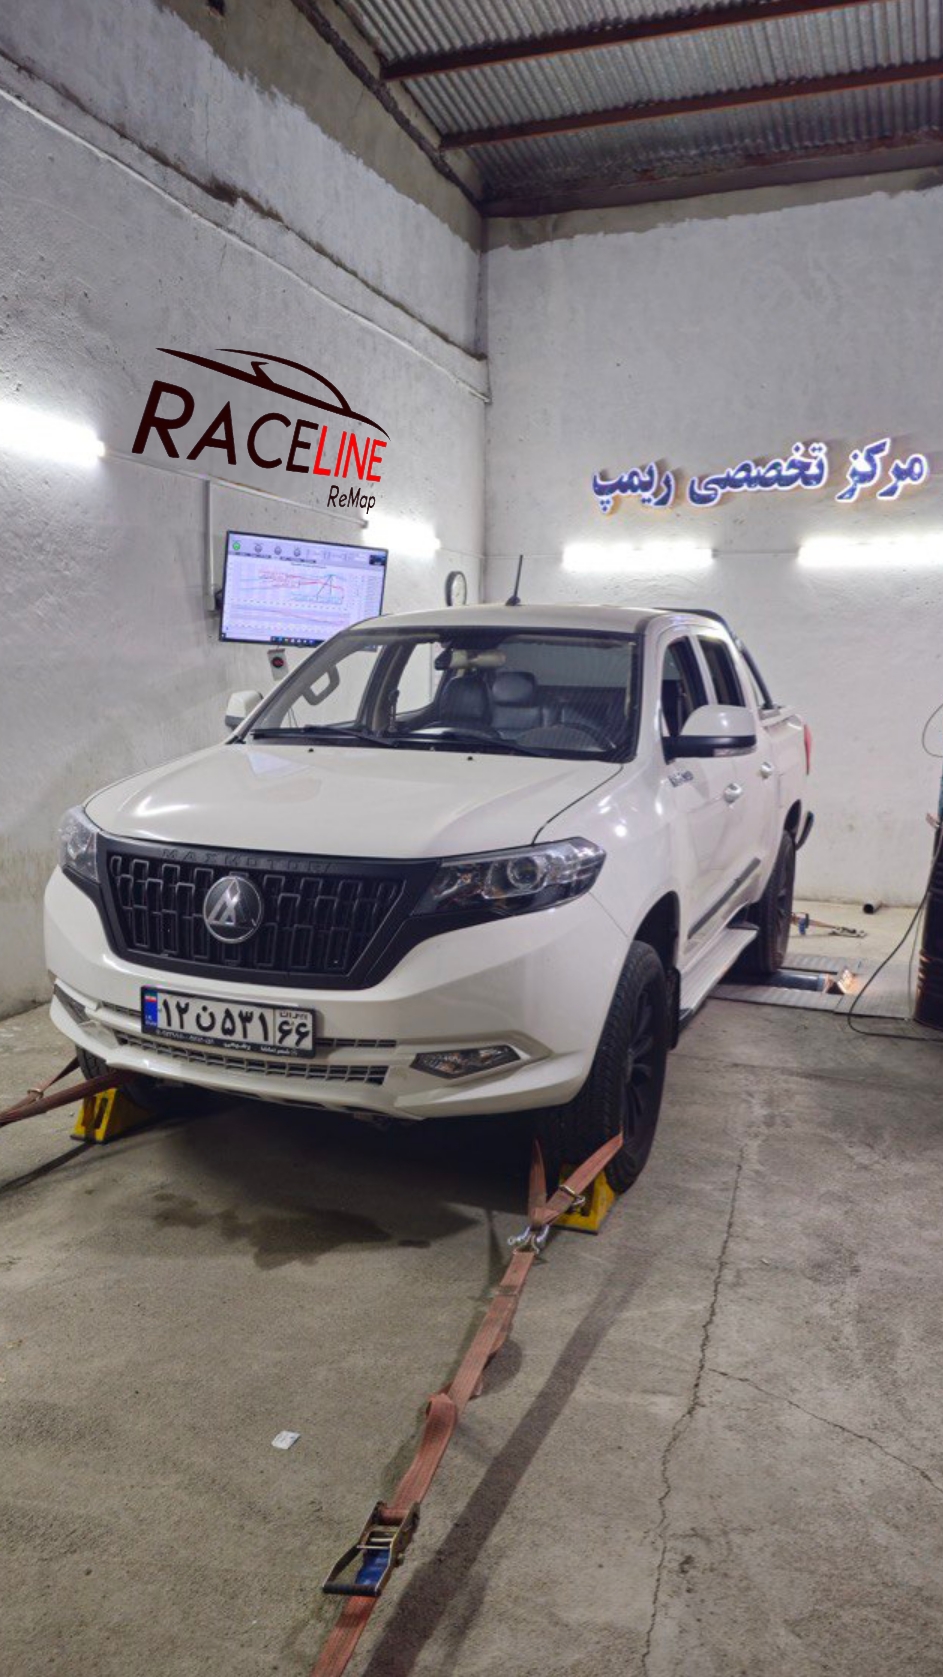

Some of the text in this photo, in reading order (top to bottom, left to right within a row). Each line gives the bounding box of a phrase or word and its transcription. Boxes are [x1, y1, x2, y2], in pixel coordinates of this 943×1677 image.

[591, 437, 928, 514] مرکز تخصصی ریمپ
